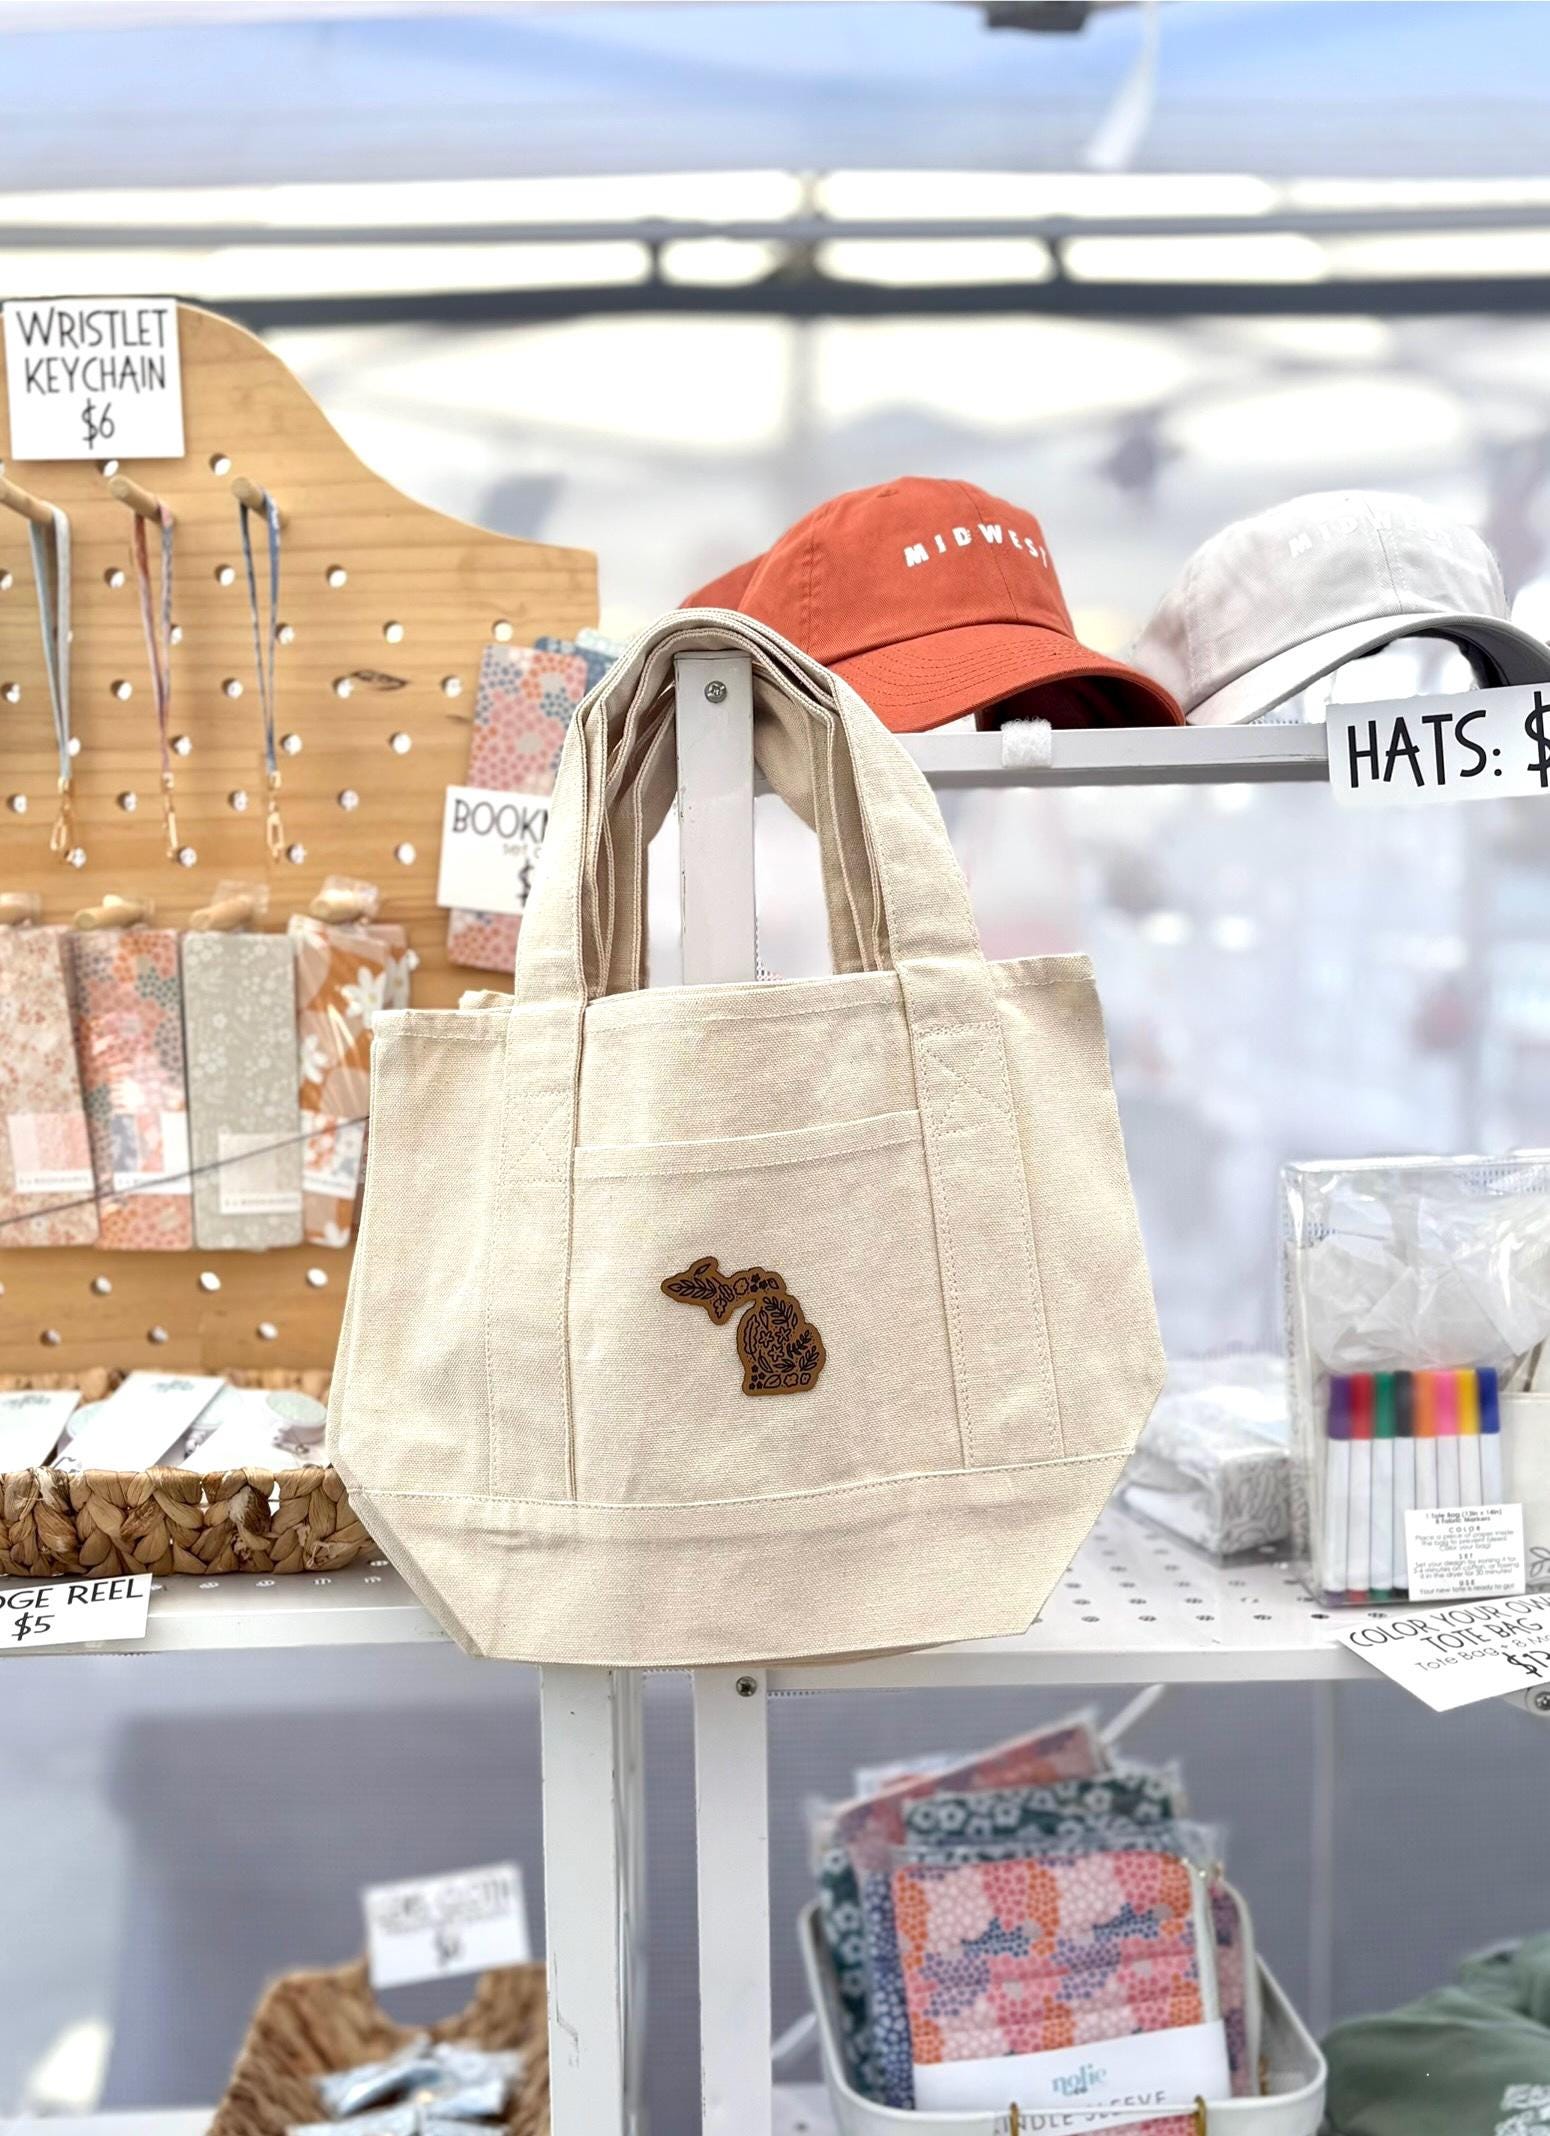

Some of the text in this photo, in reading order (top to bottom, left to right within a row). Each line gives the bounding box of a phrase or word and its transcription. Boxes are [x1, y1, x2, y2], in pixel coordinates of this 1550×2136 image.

[16, 306, 168, 349] WRISTLET
[25, 355, 165, 395] KEYCHAIN
[81, 398, 115, 450] $6
[1348, 709, 1502, 788] HATS:
[67, 1578, 143, 1605] REEL
[11, 1611, 55, 1641] $5
[1349, 1596, 1550, 1647] COLOR YOUR OW
[1420, 1617, 1543, 1653] TOTE BAG
[1414, 1657, 1458, 1672] Tote
[1457, 1647, 1499, 1660] Bag
